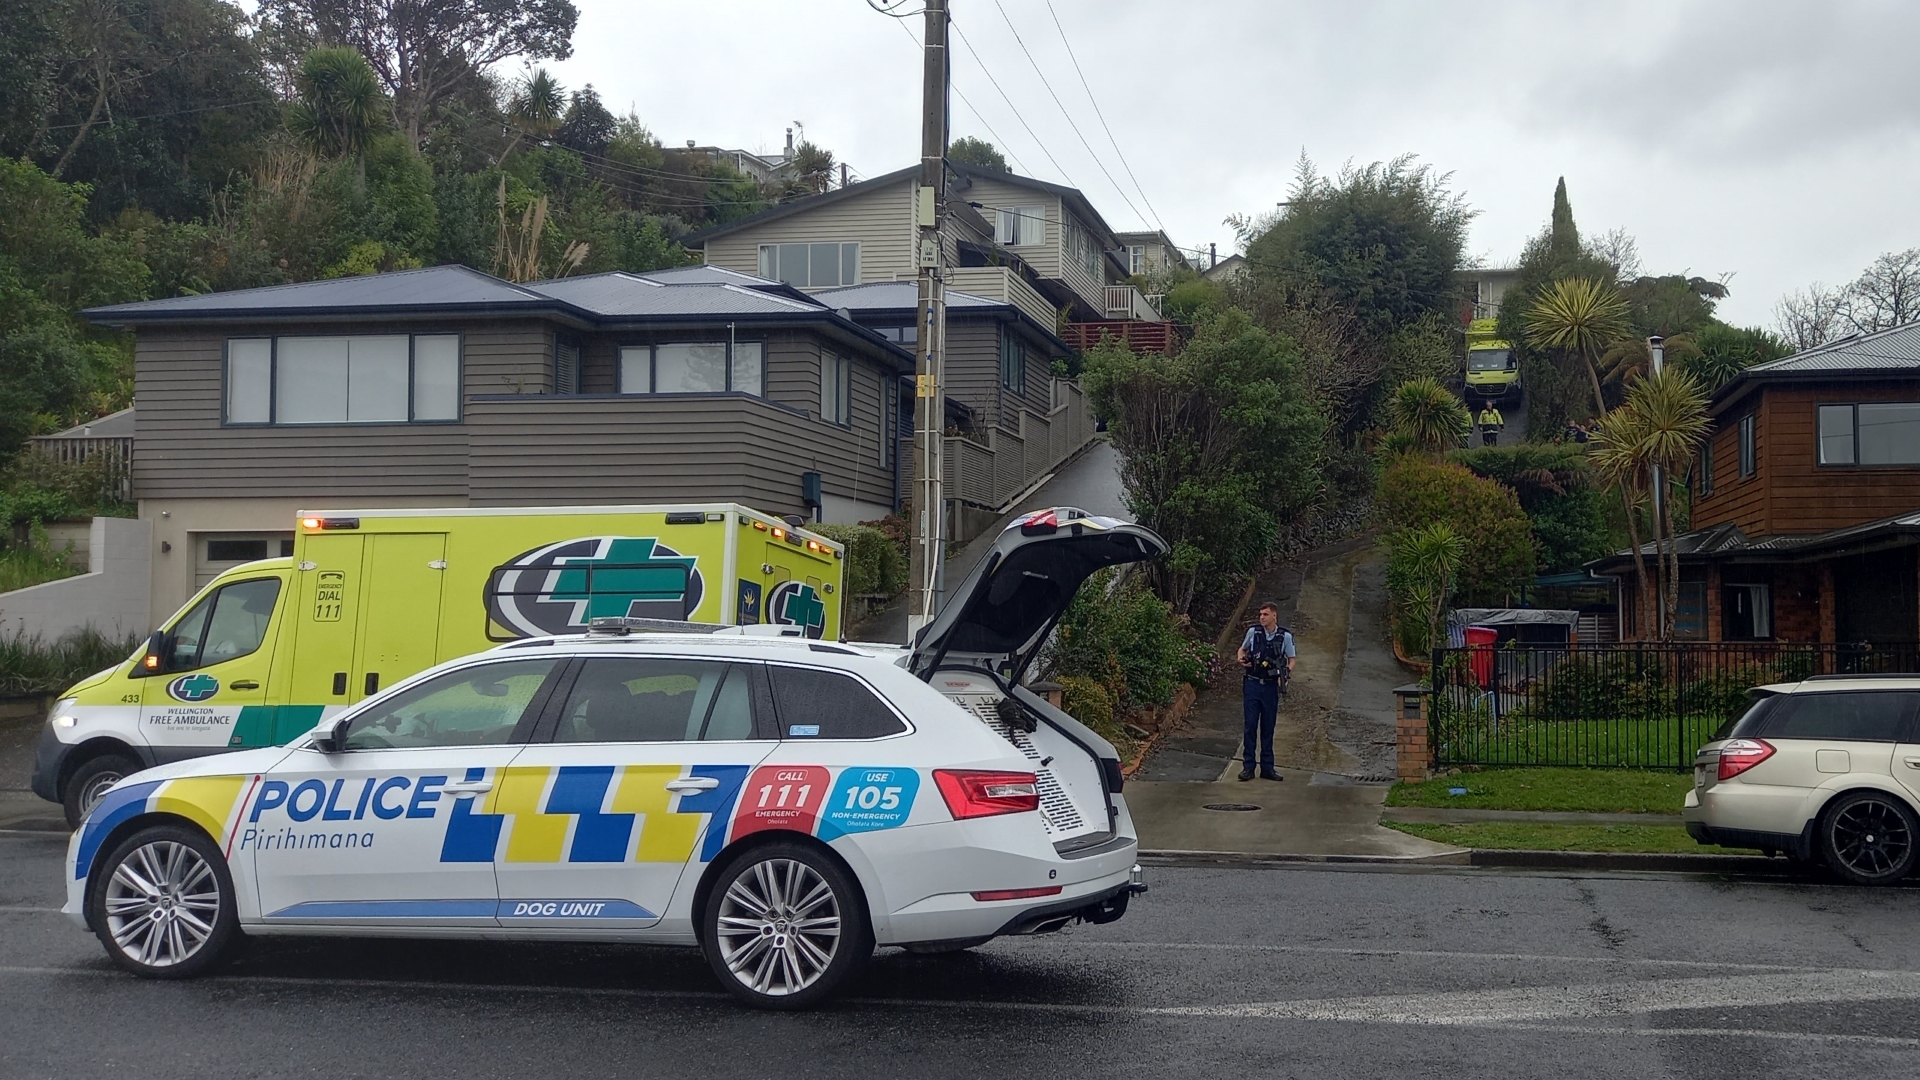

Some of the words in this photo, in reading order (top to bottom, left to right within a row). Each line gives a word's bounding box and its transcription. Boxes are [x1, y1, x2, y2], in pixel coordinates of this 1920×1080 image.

[318, 590, 340, 600] DIAL
[316, 604, 340, 618] 111
[121, 694, 140, 703] 433
[150, 716, 172, 724] FREE
[174, 716, 230, 724] AMBULANCE
[777, 772, 804, 780] CALL
[866, 773, 889, 782] USE
[248, 775, 448, 823] POLICE
[757, 784, 812, 808] 111
[844, 786, 902, 810] 105
[240, 827, 374, 850] Pirihimana
[514, 902, 557, 916] DOG
[560, 903, 605, 916] UNIT
